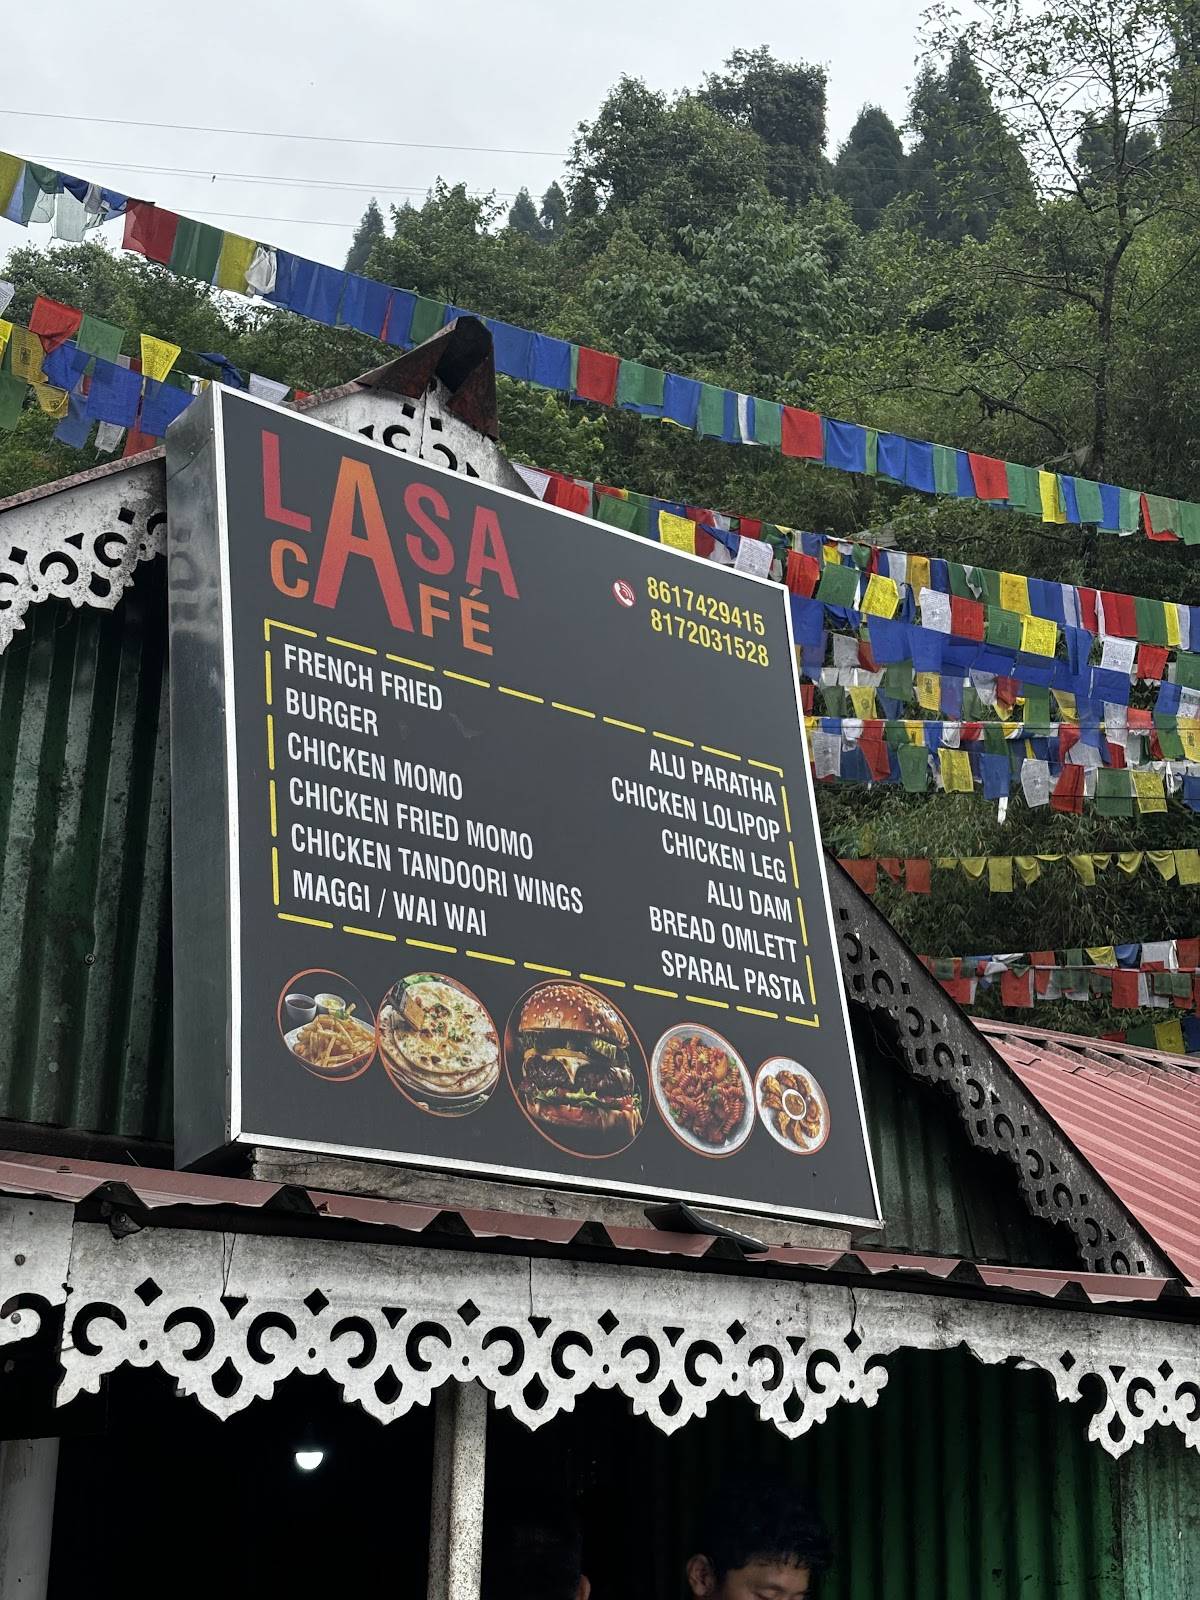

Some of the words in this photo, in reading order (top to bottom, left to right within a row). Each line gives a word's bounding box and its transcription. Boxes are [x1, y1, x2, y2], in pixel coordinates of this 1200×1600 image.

[262, 430, 519, 632] LASA
[270, 456, 493, 656] CAFÉ
[647, 577, 765, 635] 8617429415
[651, 609, 769, 667] 8172031528
[285, 644, 373, 692] FRENCH
[381, 671, 442, 710] FRIED
[286, 688, 378, 736] BURGER
[288, 732, 386, 781] CHICKEN
[394, 759, 462, 800] MOMO
[650, 749, 685, 779] ALU
[692, 760, 776, 805] PARATHA
[290, 777, 388, 825] CHICKEN
[397, 803, 458, 841] FRIED
[467, 820, 532, 859] MOMO
[612, 777, 697, 821] CHICKEN
[703, 801, 780, 842] LOLIPOP
[292, 824, 391, 871] CHICKEN
[398, 847, 507, 897] TANDOORI
[514, 874, 583, 913] WINGS
[662, 829, 745, 872] CHICKEN
[751, 852, 786, 883] LEG
[293, 870, 370, 912] MAGGI
[378, 889, 386, 918] /
[393, 891, 437, 926] WAI
[444, 902, 486, 936] WAI
[708, 880, 743, 910] ALU
[749, 890, 792, 923] DAM
[649, 906, 715, 943] BREAD
[722, 923, 796, 963] OMLETT
[662, 950, 739, 990] SPARAL
[744, 968, 805, 1004] PASTA
